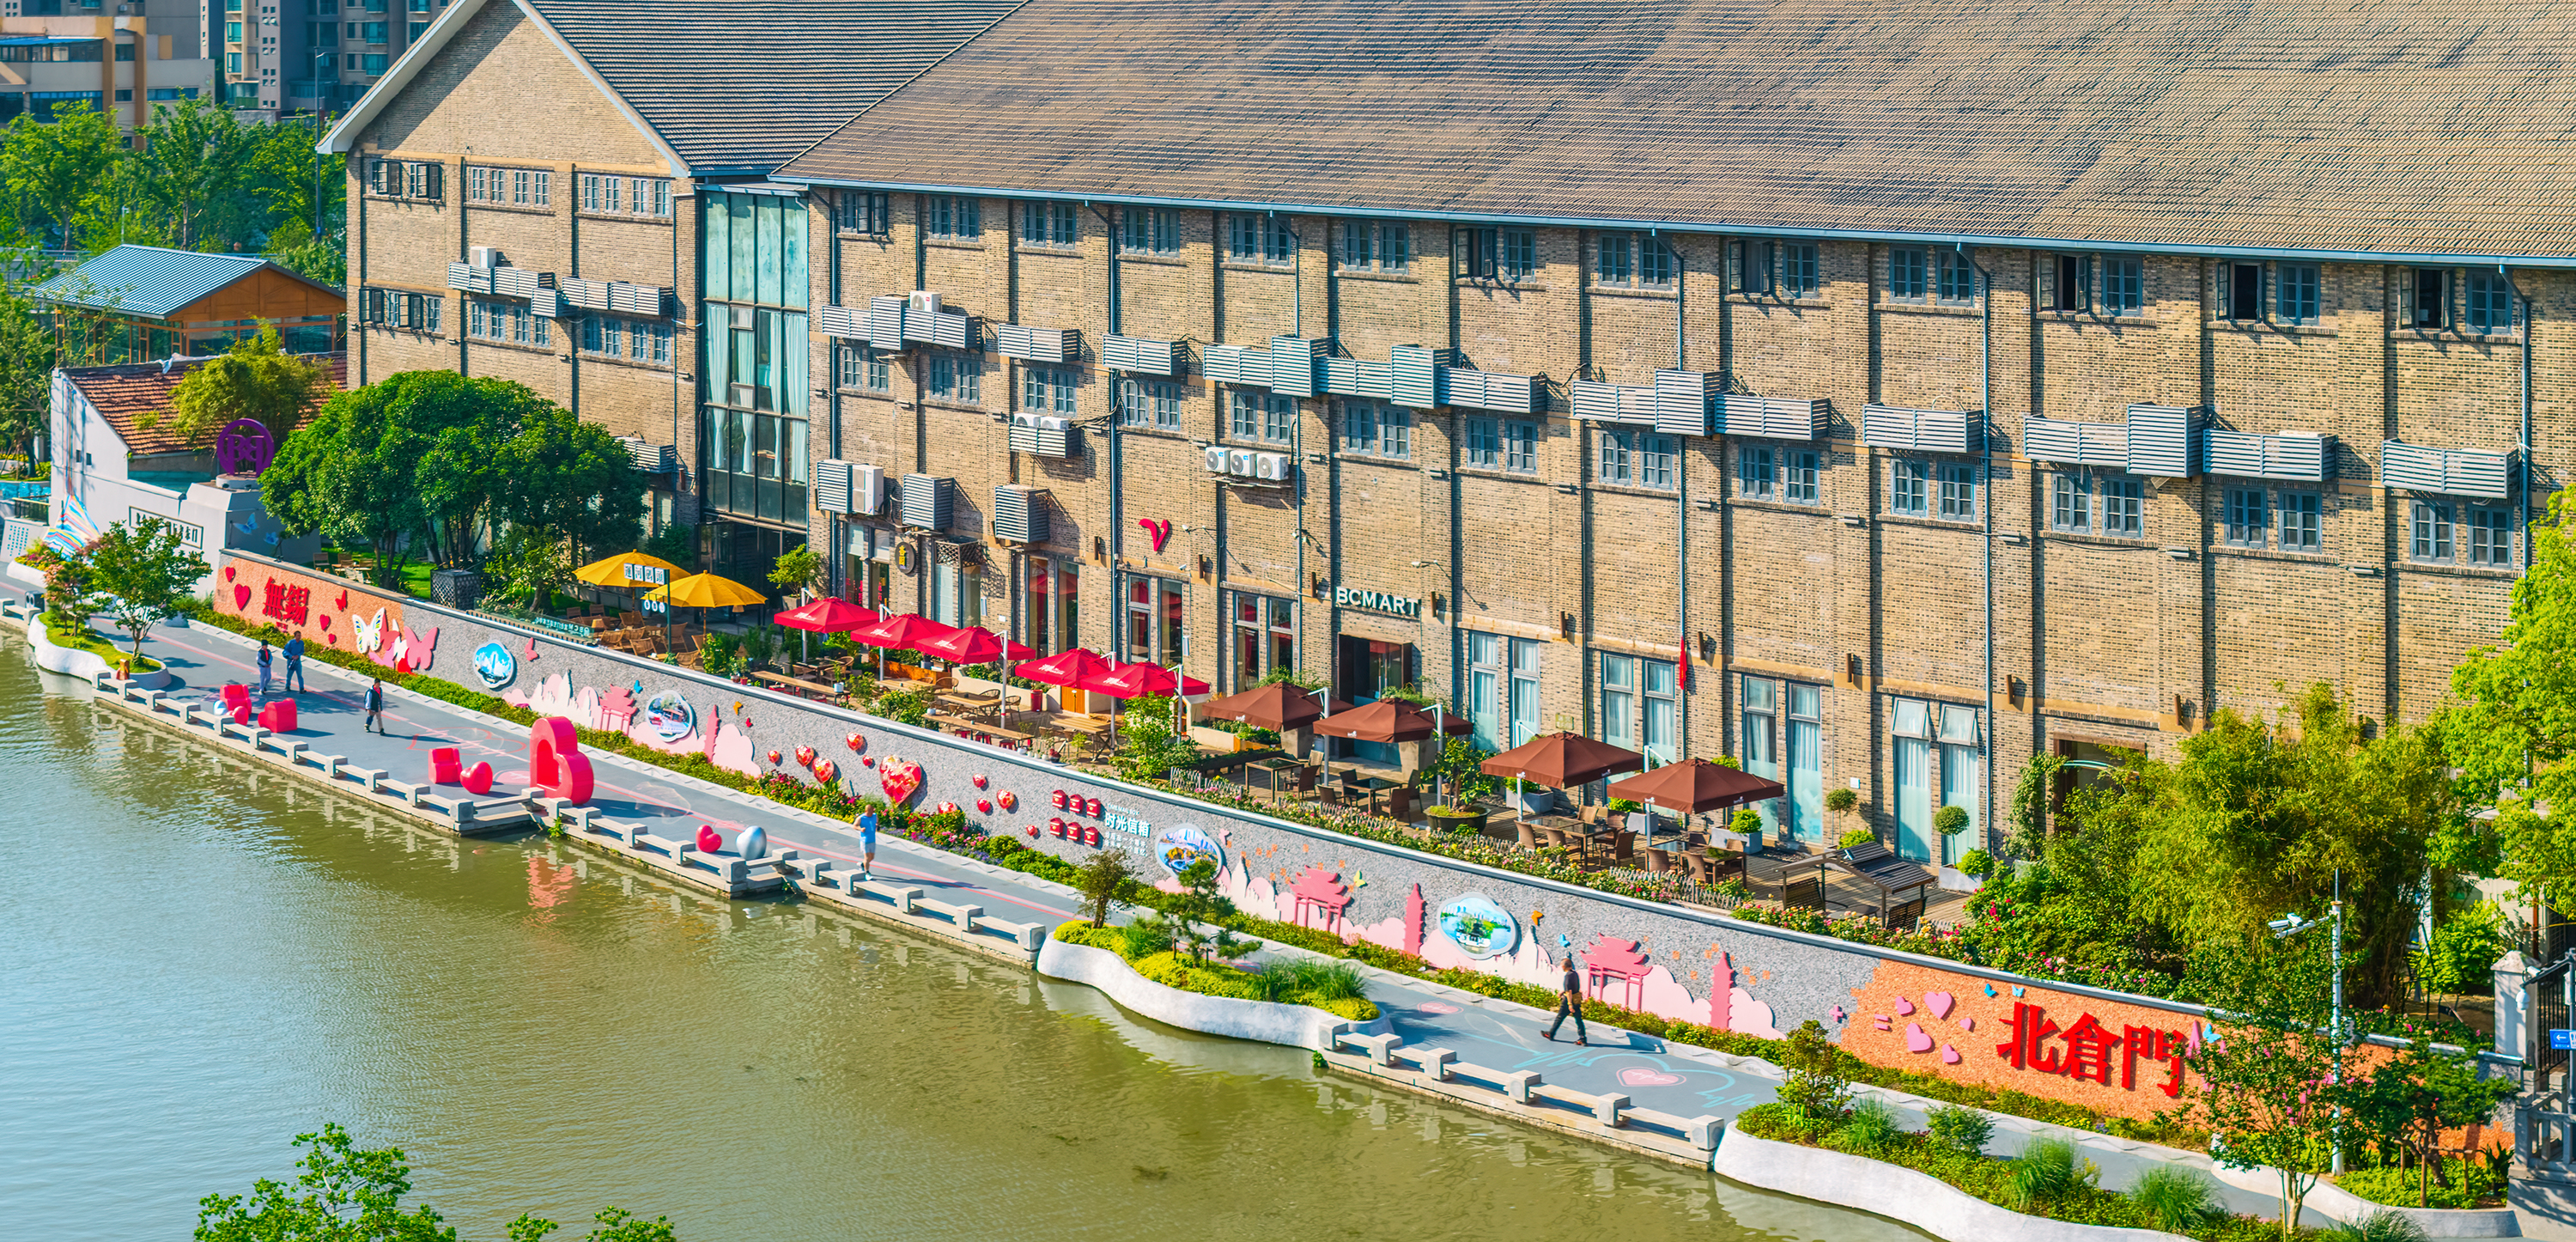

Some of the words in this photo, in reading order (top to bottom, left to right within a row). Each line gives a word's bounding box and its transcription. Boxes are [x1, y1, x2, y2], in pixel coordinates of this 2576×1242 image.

[263, 576, 310, 625] 無錫
[1336, 587, 1419, 615] BCMART
[1104, 812, 1151, 837] 时光信箱
[1996, 1002, 2184, 1097] 北倉門
